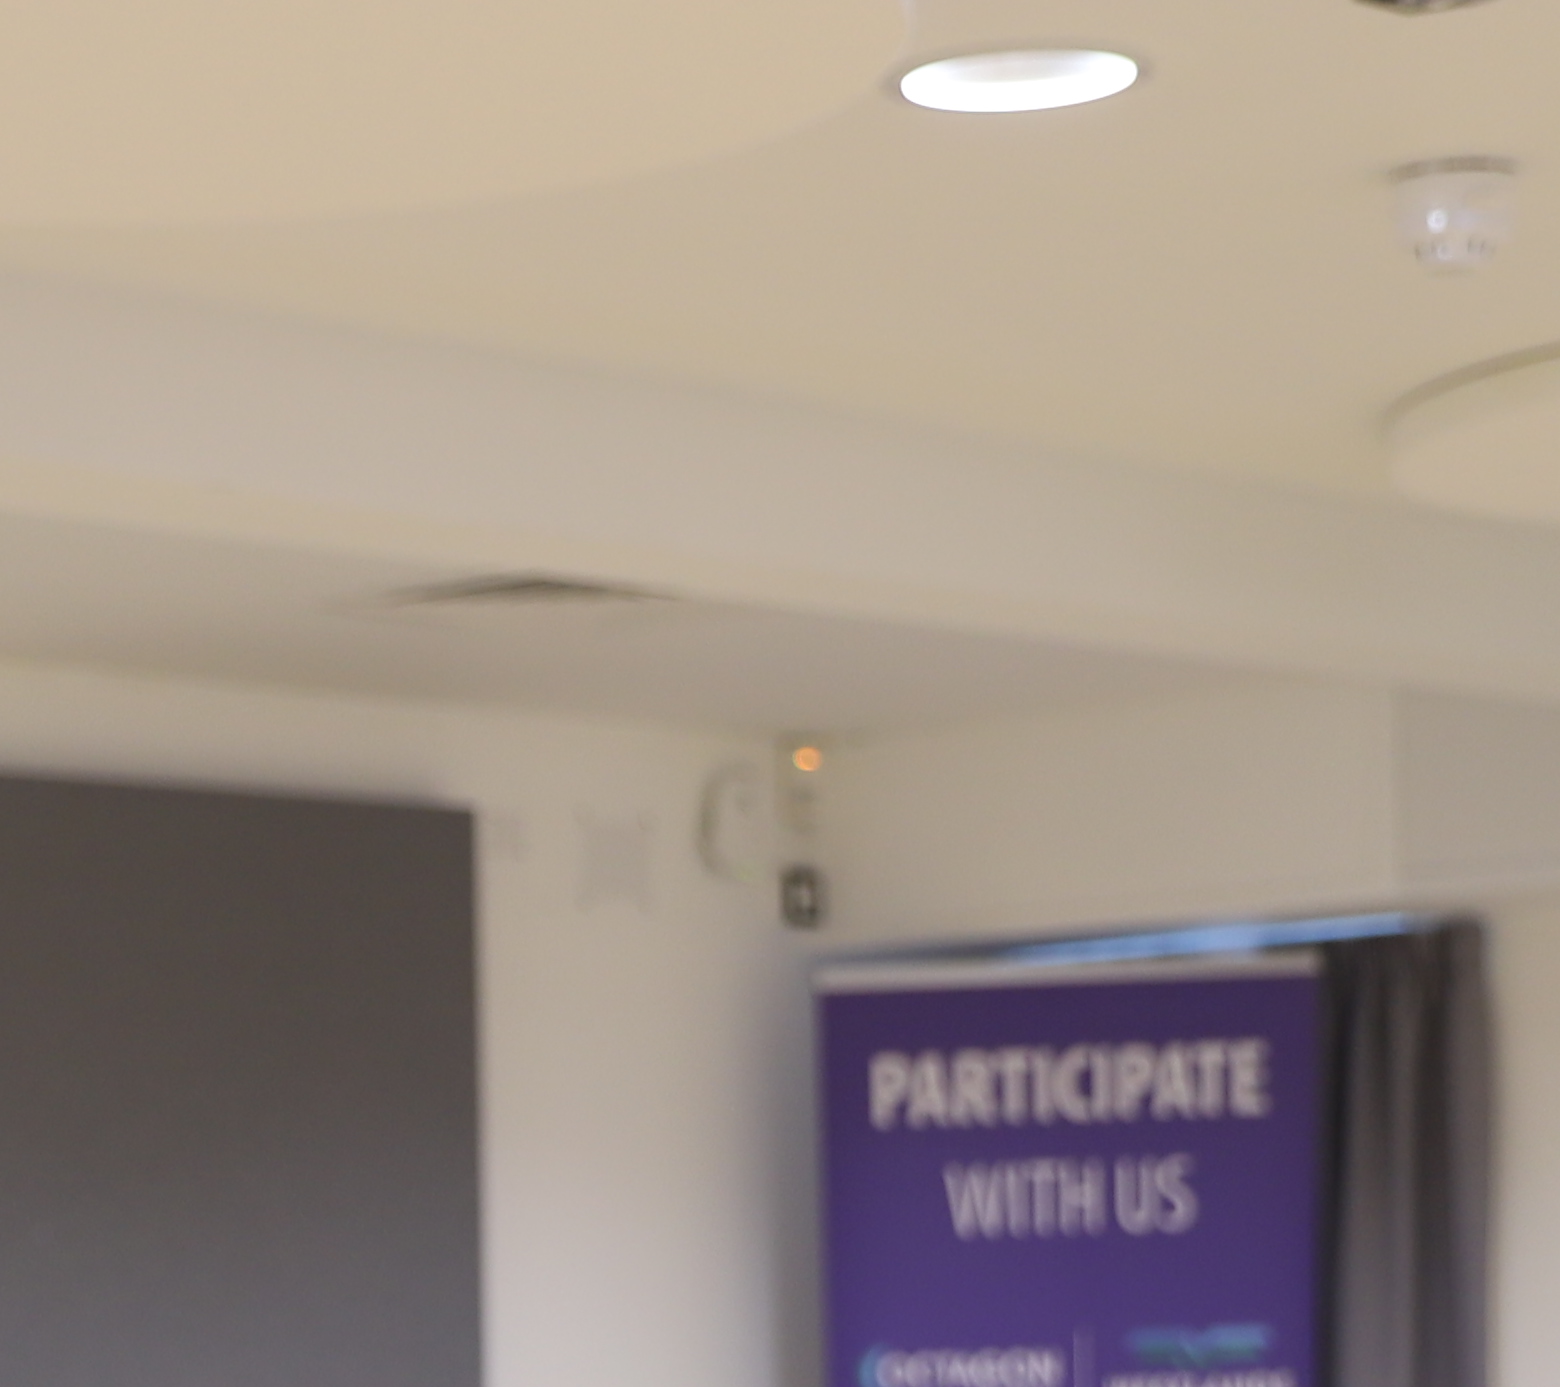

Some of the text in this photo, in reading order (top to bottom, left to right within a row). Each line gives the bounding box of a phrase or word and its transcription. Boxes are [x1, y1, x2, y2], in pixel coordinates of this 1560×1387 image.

[870, 1038, 1270, 1131] PARTICIPATE
[943, 1151, 1199, 1241] WITH US
